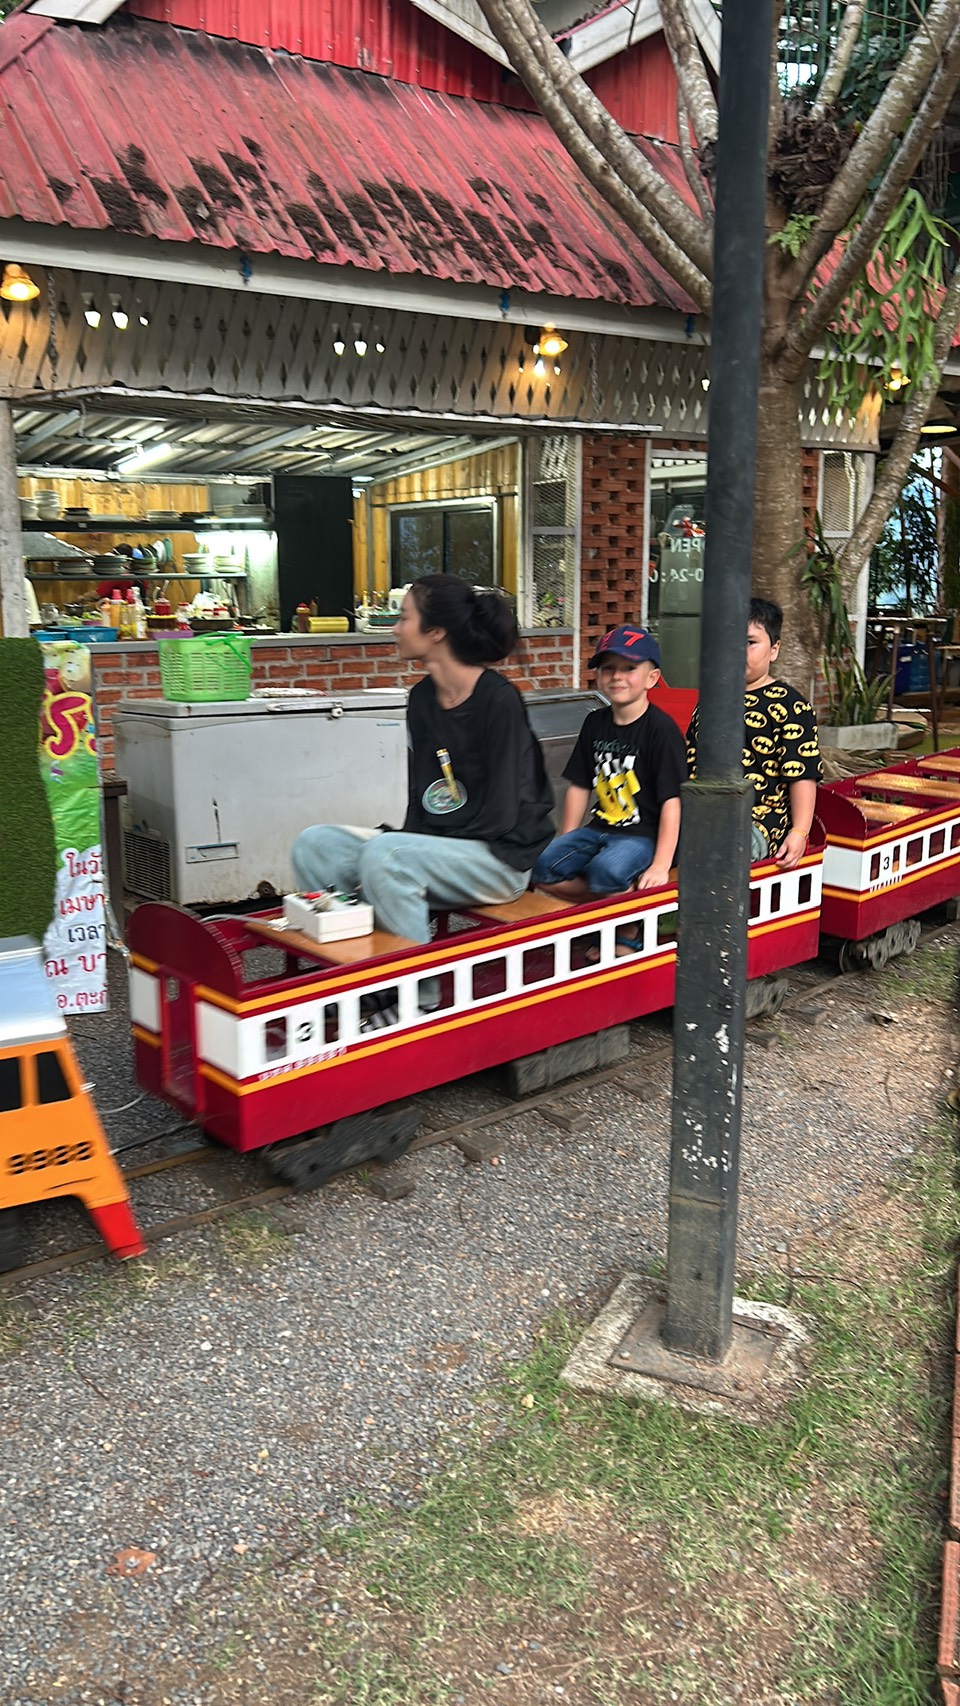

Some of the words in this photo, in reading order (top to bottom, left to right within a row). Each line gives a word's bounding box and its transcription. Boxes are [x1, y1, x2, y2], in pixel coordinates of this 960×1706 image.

[622, 630, 645, 647] 7
[883, 856, 890, 870] 3
[296, 1021, 314, 1043] 3
